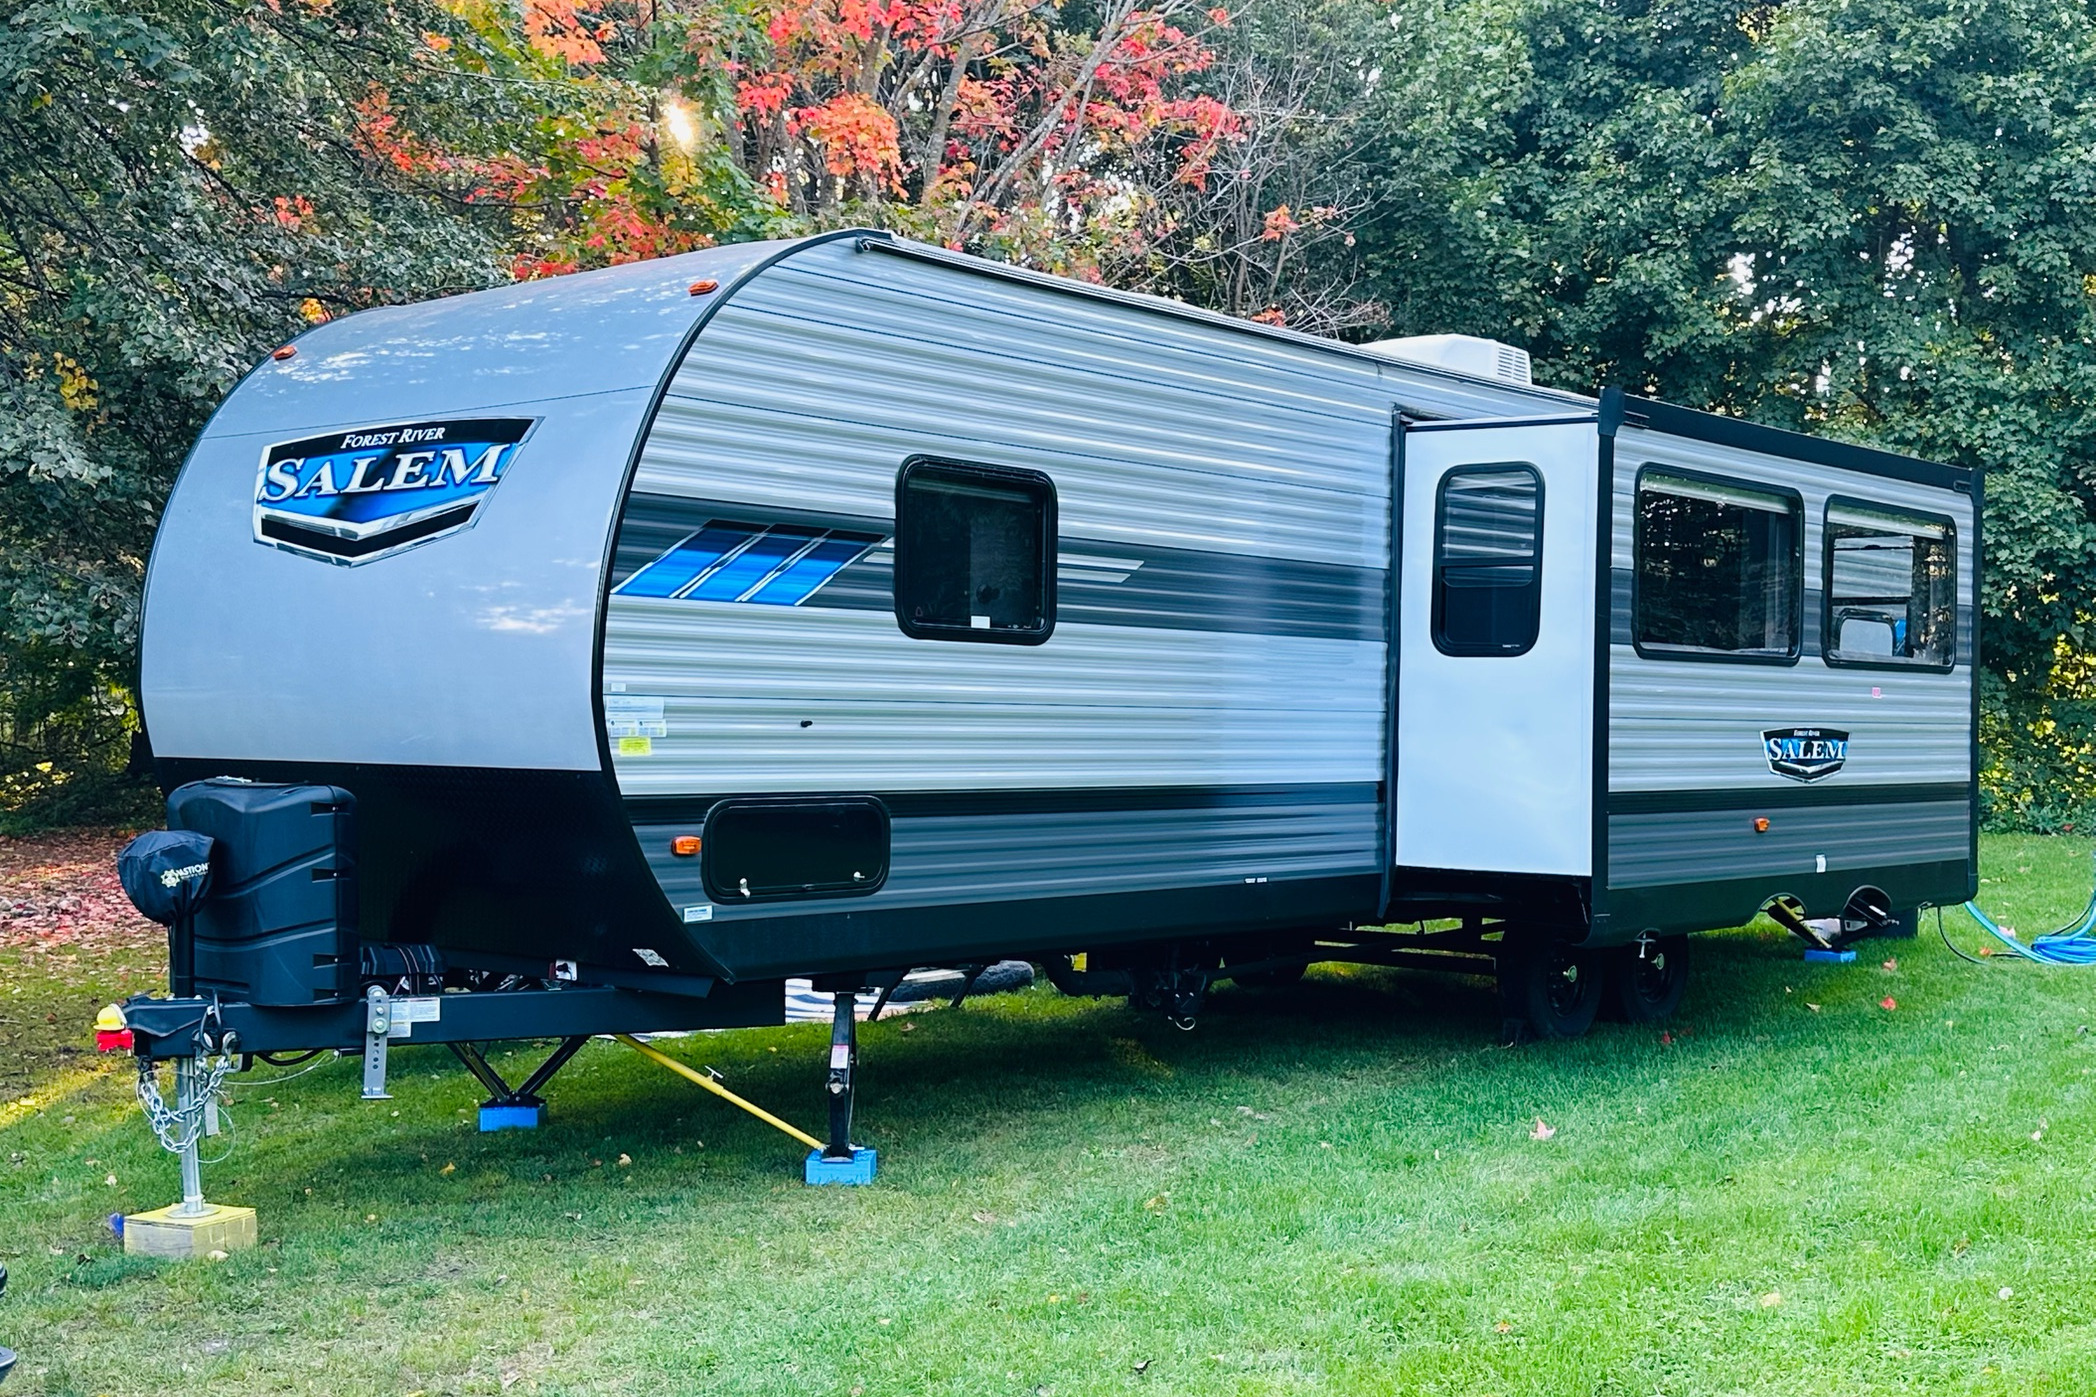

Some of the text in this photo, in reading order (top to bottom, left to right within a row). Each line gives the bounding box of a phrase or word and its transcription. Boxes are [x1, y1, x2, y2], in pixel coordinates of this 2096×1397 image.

[341, 427, 446, 449] FOREST RIVER
[257, 444, 510, 502] SALEM
[1769, 737, 1845, 761] SALEM
